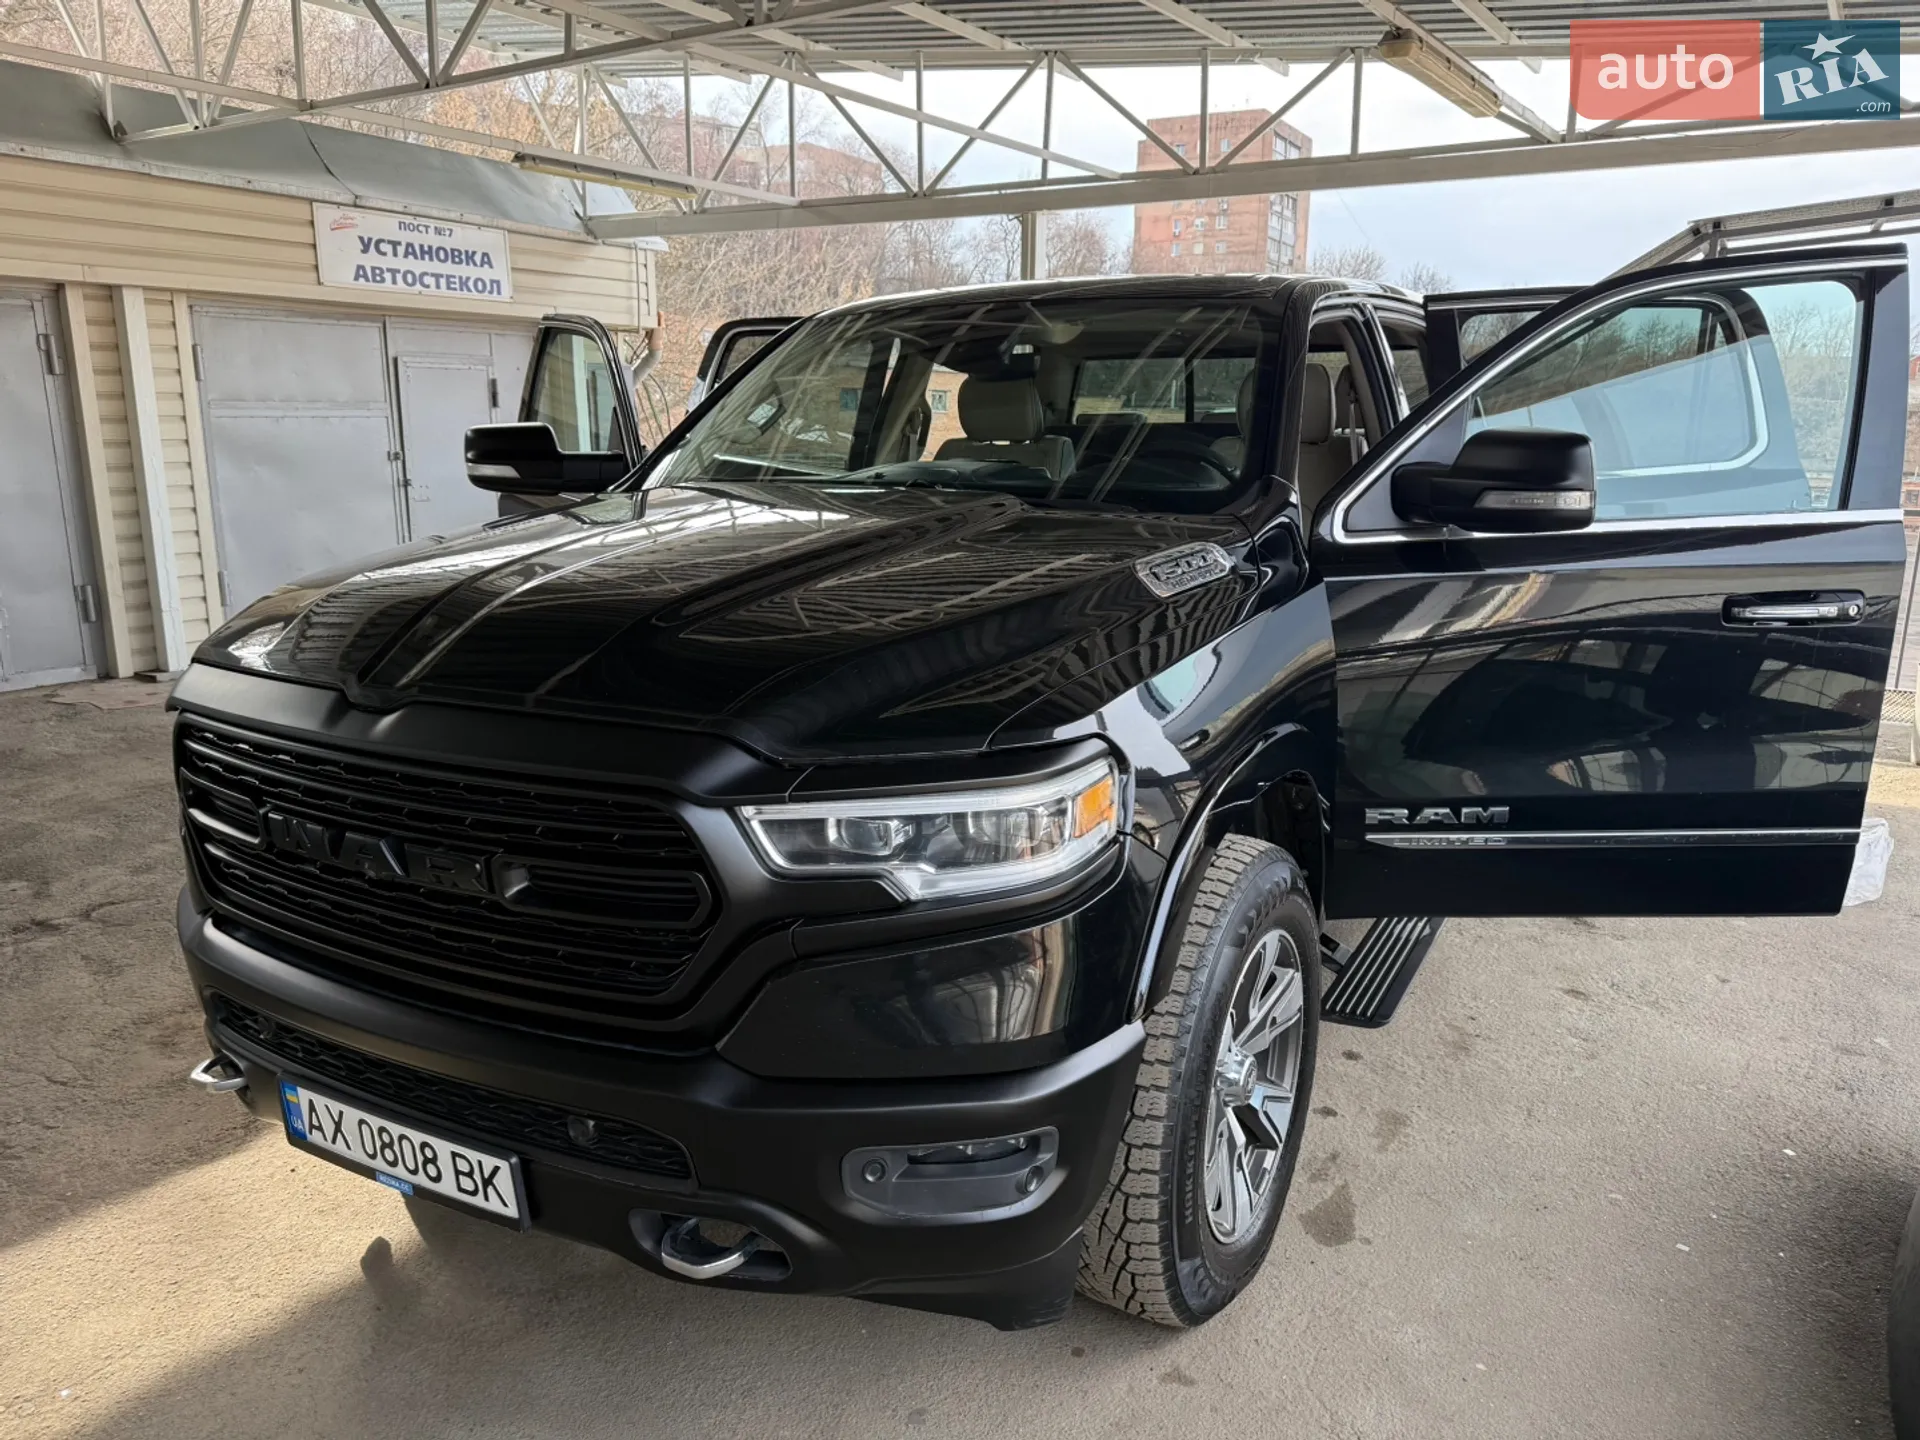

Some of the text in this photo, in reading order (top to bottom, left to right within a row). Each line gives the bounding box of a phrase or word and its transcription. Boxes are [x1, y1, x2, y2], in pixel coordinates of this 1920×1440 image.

[398, 220, 454, 238] ПОСТ №7
[357, 235, 494, 270] УСТАНОВКА
[353, 264, 503, 296] АВТОСТЕКОЛ
[1149, 551, 1214, 583] 1500
[1364, 806, 1510, 824] RAM
[1393, 837, 1508, 846] LIMITED
[290, 1115, 305, 1131] UA
[307, 1098, 510, 1208] AX 0808 BK
